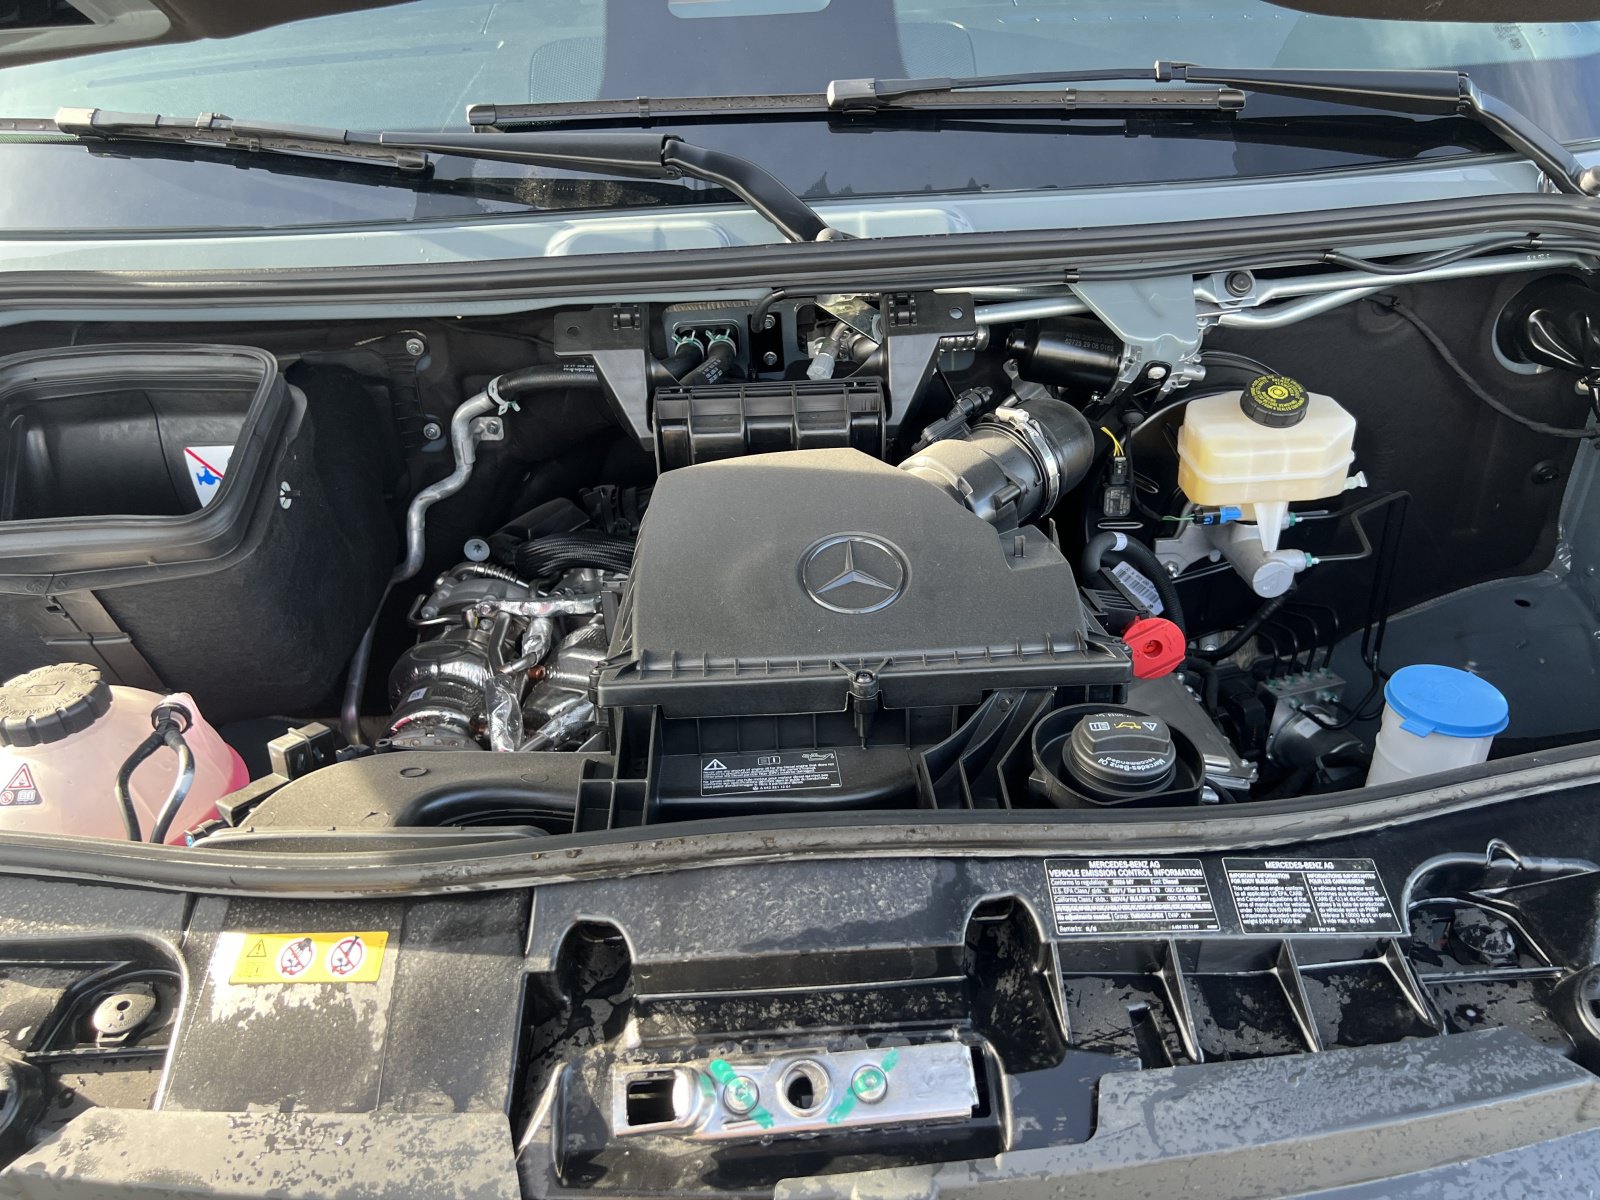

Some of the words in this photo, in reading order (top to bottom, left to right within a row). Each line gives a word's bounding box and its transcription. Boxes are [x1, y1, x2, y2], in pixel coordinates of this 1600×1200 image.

[1106, 756, 1156, 765] recommended
[1109, 758, 1166, 771] Mercedes-Benz
[1048, 869, 1080, 877] VEHICLE
[1080, 868, 1116, 877] EMISSION
[1117, 868, 1152, 876] CONTROL
[1152, 868, 1202, 876] INFORMATION
